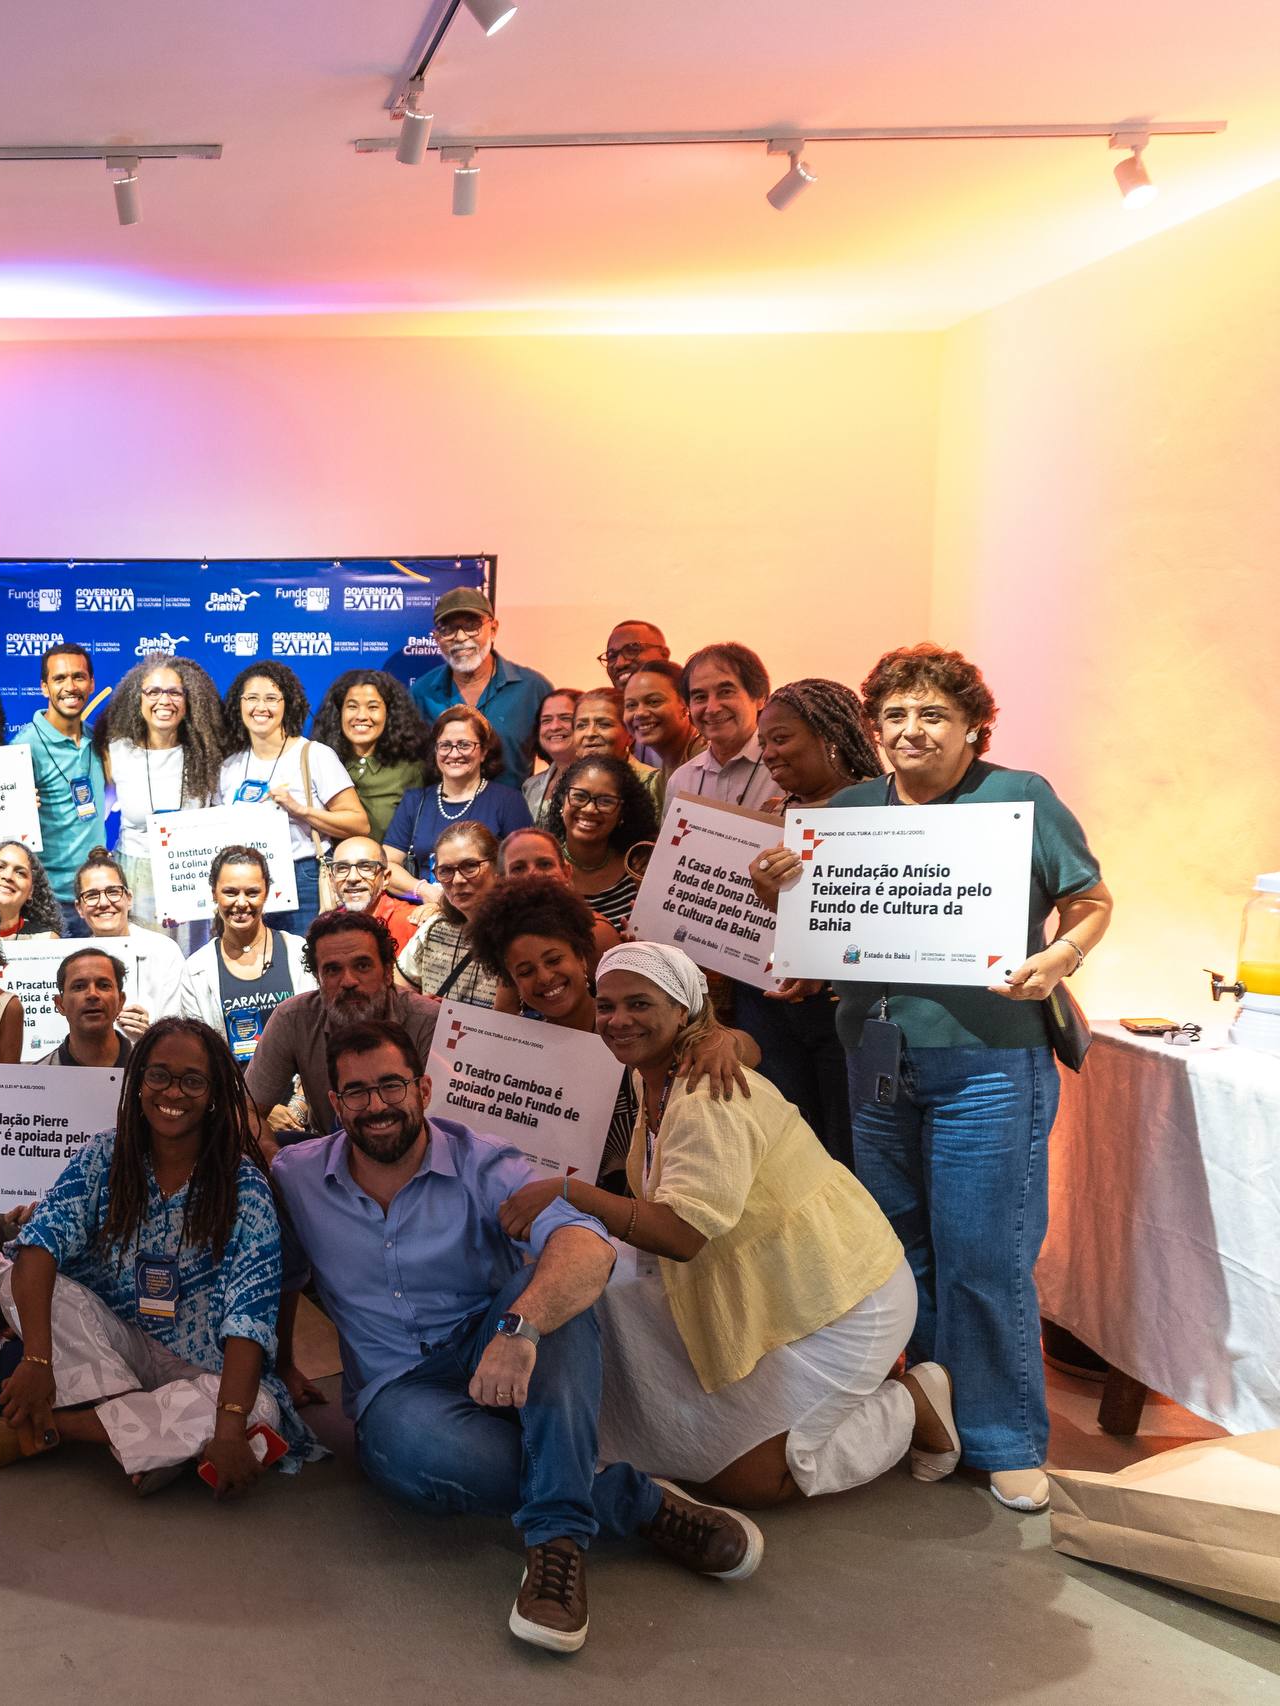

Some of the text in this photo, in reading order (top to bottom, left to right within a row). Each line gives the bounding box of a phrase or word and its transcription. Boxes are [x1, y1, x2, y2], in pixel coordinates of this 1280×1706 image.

[8, 588, 40, 599] Fundo
[76, 588, 134, 596] GOVERNO DA
[276, 588, 307, 599] Fundo
[344, 587, 403, 595] GOVERNO DA
[210, 592, 240, 602] Bahia
[27, 599, 40, 608] de
[75, 596, 134, 612] BAHIA
[205, 601, 246, 611] Criativa
[294, 598, 307, 608] de
[343, 595, 404, 611] BAHIA
[6, 633, 64, 641] GOVERNO DA
[204, 632, 235, 643] Fundo
[272, 632, 331, 640] GOVERNO DA
[140, 637, 170, 647] Bahia
[223, 643, 235, 653] de
[272, 640, 332, 656] BAHIA
[0, 792, 6, 801] é
[168, 851, 174, 859] O
[177, 848, 212, 858] Instituto
[169, 860, 208, 870] da Colina
[678, 855, 686, 867] A
[688, 858, 712, 875] Casa
[713, 866, 727, 880] do
[170, 870, 210, 881] Fundo de
[813, 864, 950, 880] A Fundação Anísio
[171, 883, 196, 892] Bahia
[673, 869, 700, 887] Roda
[701, 879, 715, 892] de
[715, 883, 744, 902] Dona
[812, 882, 992, 899] Teixeira é apoiada pelo
[668, 884, 776, 931] é apoiada pelo Fundo
[810, 900, 963, 915] Fundo de Cultura da
[662, 899, 761, 943] de Cultura da Bahia
[809, 917, 851, 932] Bahia
[864, 951, 883, 959] Estado
[893, 952, 911, 960] Bahia
[7, 981, 14, 990] A
[44, 992, 49, 1002] é
[40, 1005, 51, 1014] de
[453, 1061, 563, 1100] O Teatro Gamboa é
[449, 1078, 580, 1122] apoiado pelo Fundo de
[446, 1092, 538, 1128] Cultura da Bahia
[33, 1114, 69, 1127] Pierre
[4, 1128, 12, 1140] é
[14, 1129, 63, 1144] apoiada
[1, 1144, 16, 1156] de
[18, 1145, 61, 1158] Cultura
[64, 1146, 77, 1158] da
